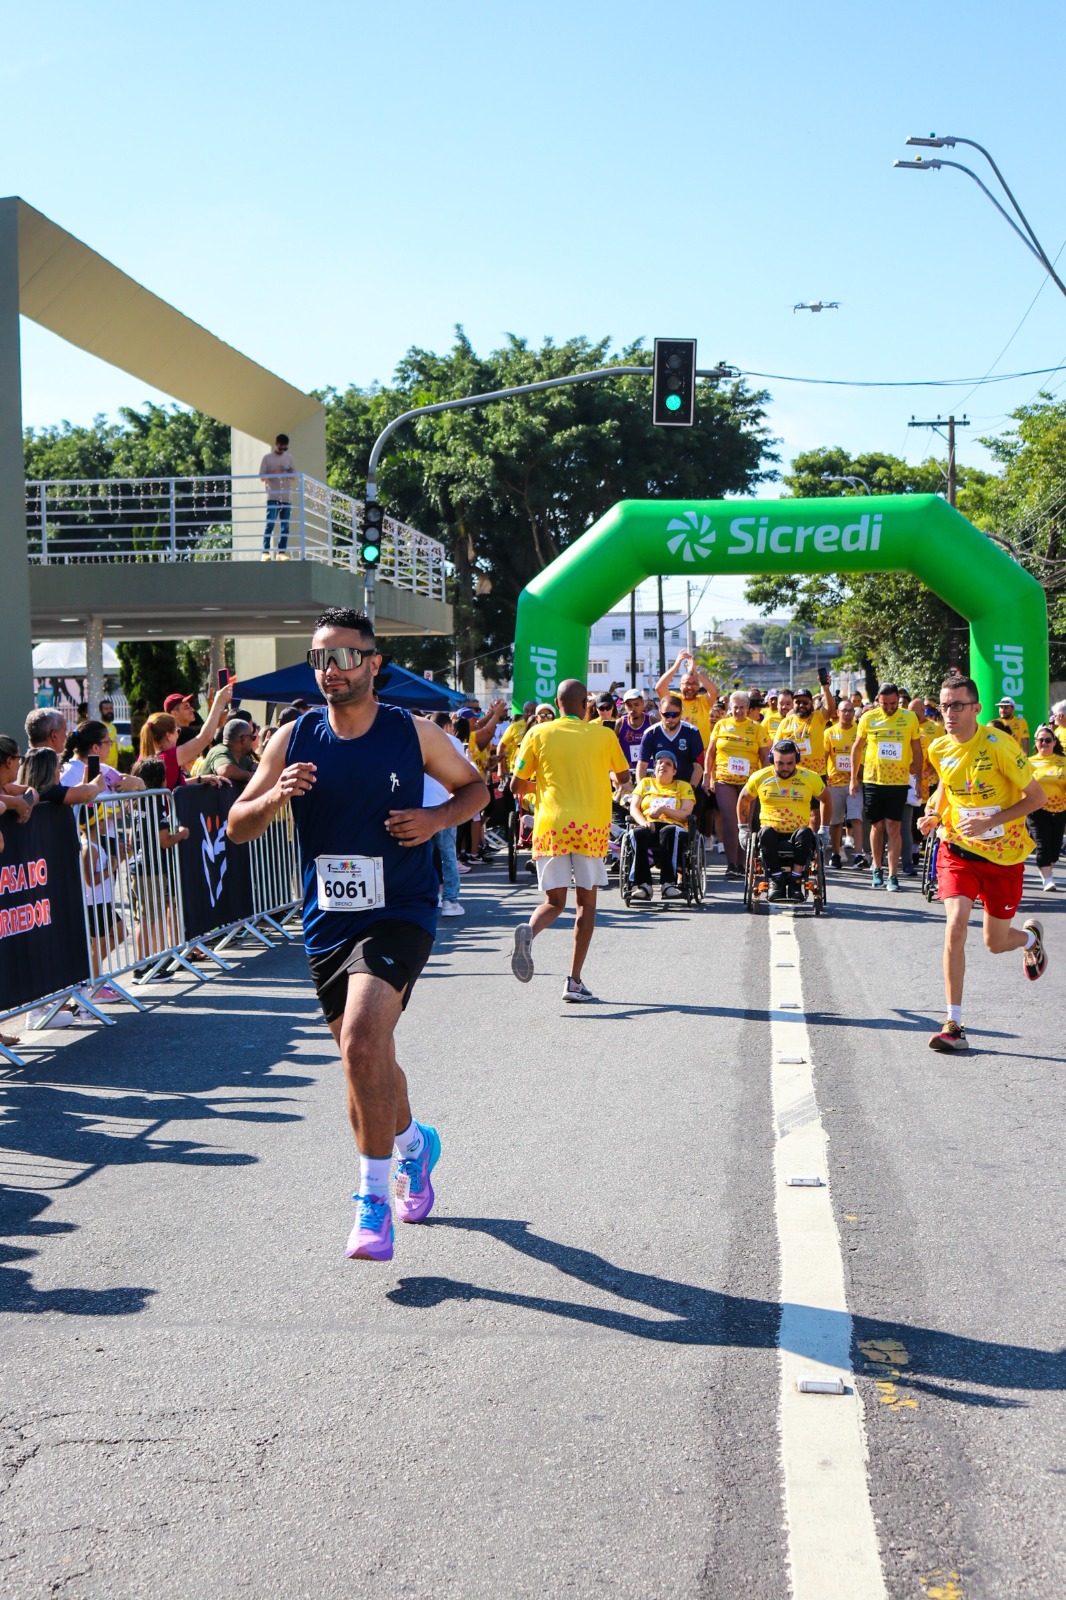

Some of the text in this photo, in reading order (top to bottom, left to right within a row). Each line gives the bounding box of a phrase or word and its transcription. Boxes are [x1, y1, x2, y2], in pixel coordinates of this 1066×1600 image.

[727, 513, 883, 555] Sicredi
[881, 749, 897, 757] 6106
[0, 858, 47, 895] ASA DO
[325, 880, 367, 899] 6061
